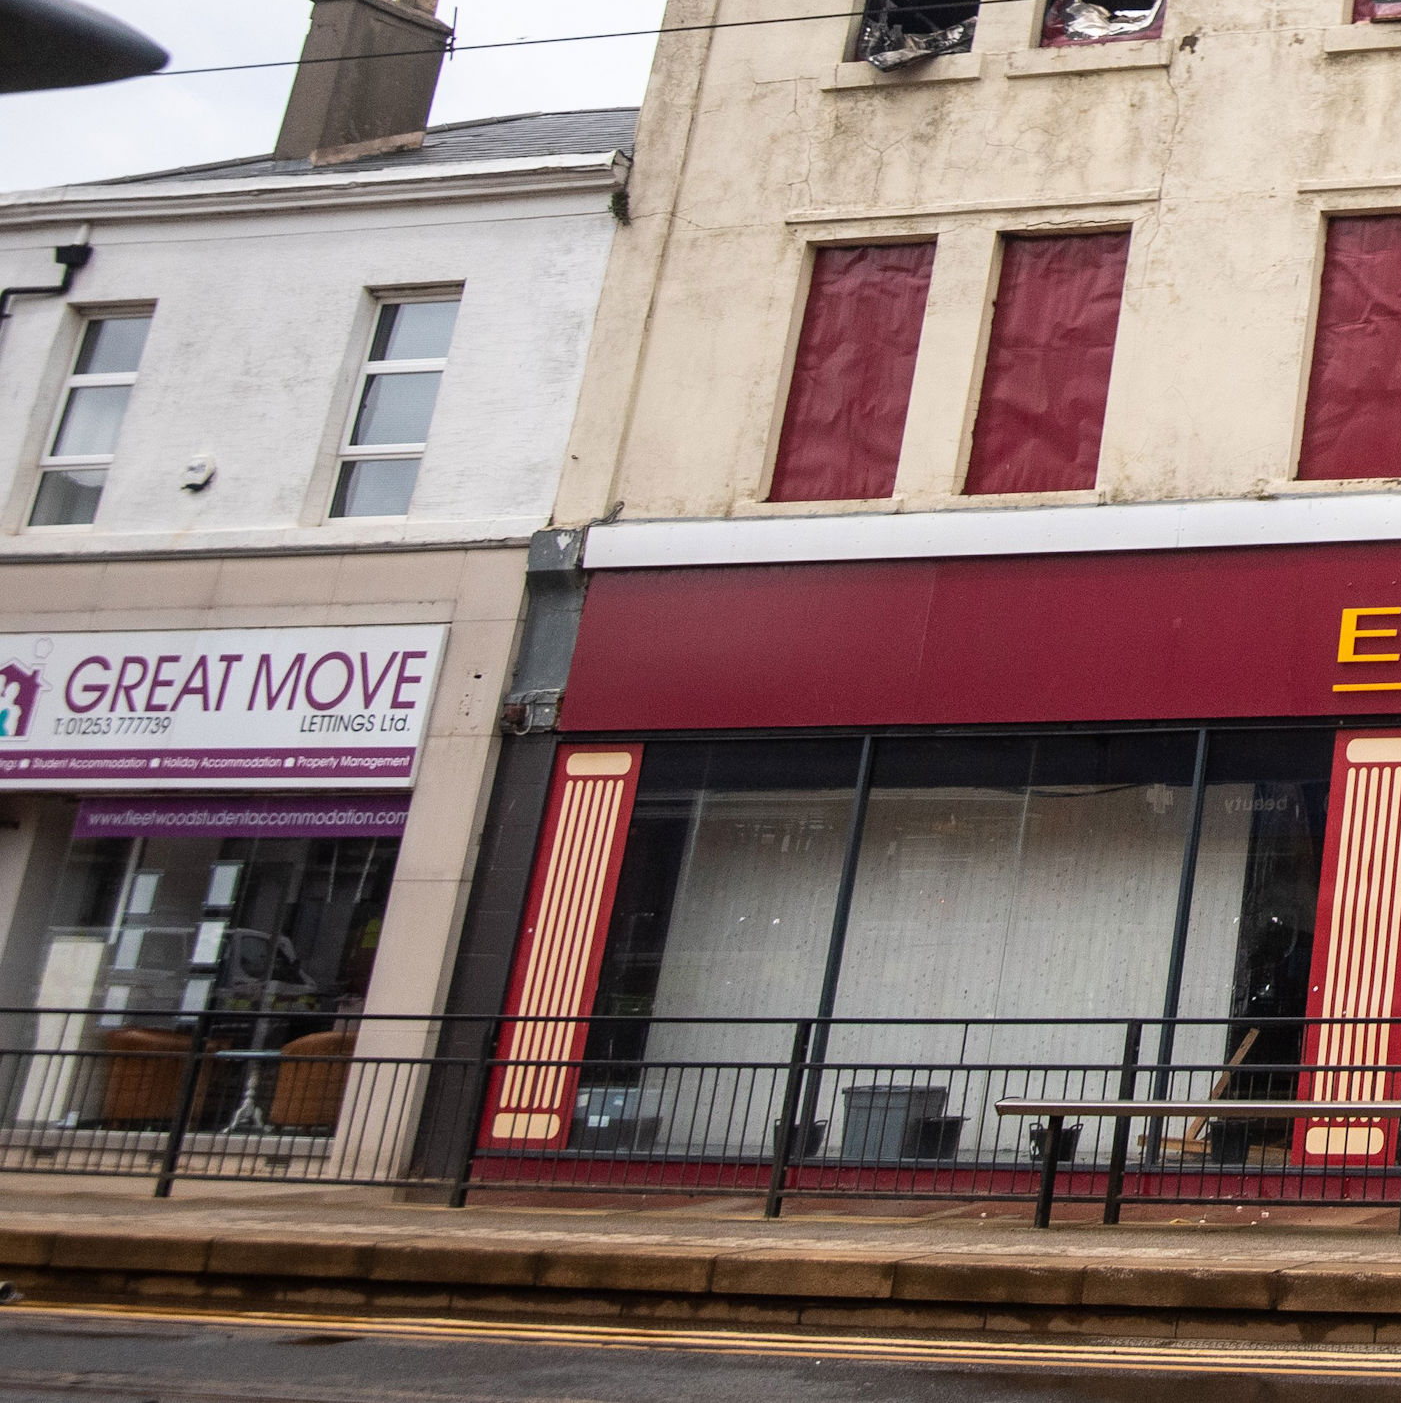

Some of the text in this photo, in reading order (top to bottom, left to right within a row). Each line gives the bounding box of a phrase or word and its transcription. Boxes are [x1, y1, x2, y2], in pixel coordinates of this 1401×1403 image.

[65, 651, 428, 713] GREAT MOVE
[115, 717, 172, 735] 777739
[300, 714, 410, 733] LETTINGS Ltd.
[33, 757, 69, 769] Student
[69, 757, 147, 769] Accommodation
[163, 757, 199, 770] Holiday
[201, 757, 282, 768] Accommodation
[297, 756, 338, 770] Property
[340, 755, 410, 769] Management
[89, 809, 409, 826] www.fleetwoodstudentaccommodation.com
